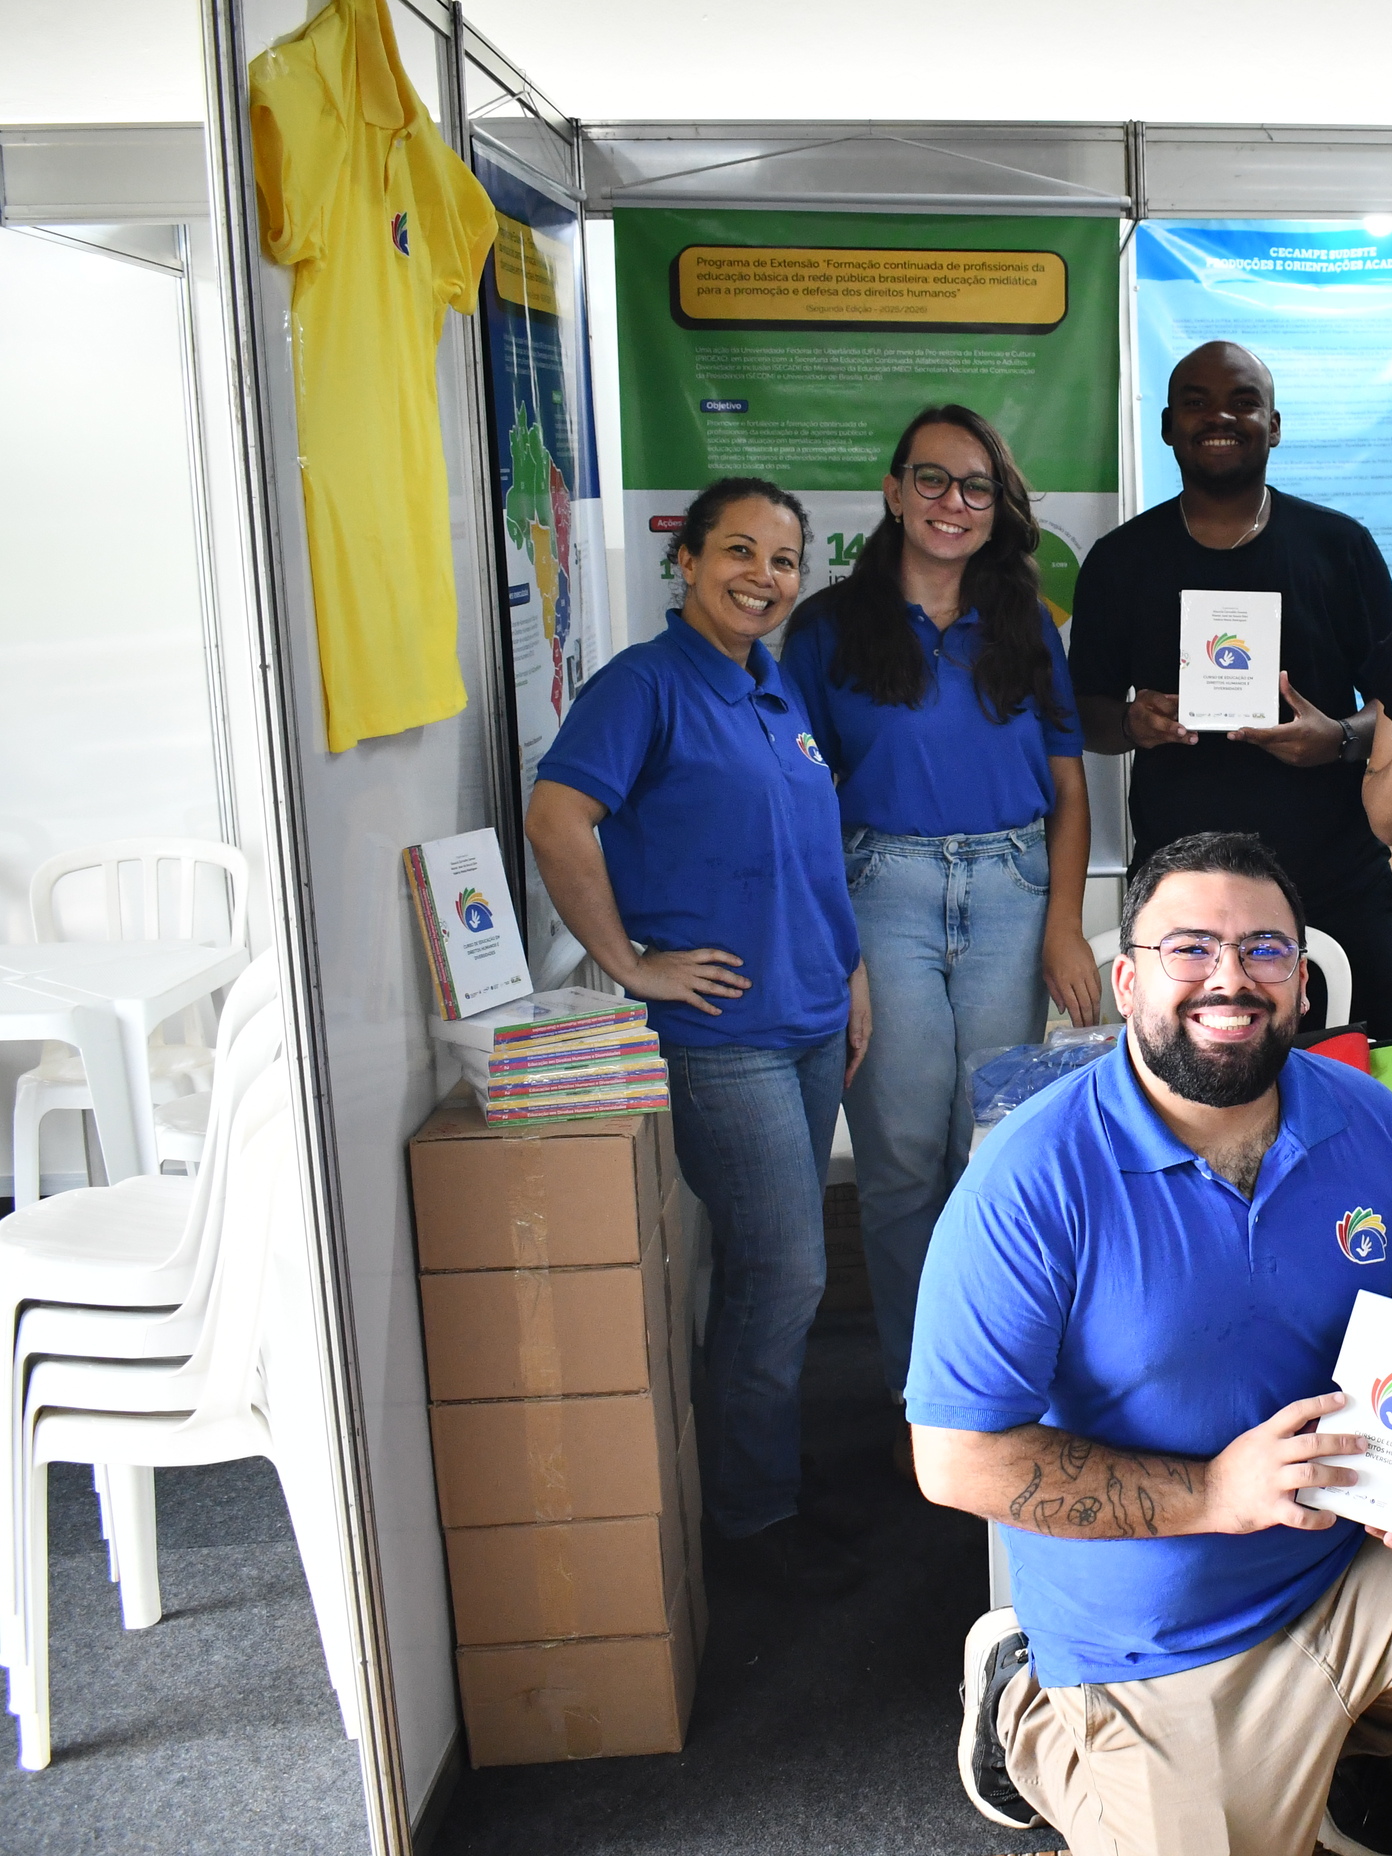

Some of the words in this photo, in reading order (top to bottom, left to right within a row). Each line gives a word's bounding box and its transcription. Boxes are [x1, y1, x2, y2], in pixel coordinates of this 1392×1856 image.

[1269, 246, 1327, 259] CECAMPE
[1331, 247, 1377, 259] SUDESTE
[697, 257, 749, 269] Programa
[754, 258, 767, 268] de
[771, 258, 820, 269] Extensão
[884, 260, 944, 271] continuada
[947, 261, 960, 271] de
[963, 261, 1030, 273] profissionais
[1032, 262, 1045, 272] da
[1205, 256, 1274, 272] PRODUÇÕES
[1276, 260, 1283, 270] E
[1285, 257, 1362, 273] ORIENTAÇÕES
[696, 271, 751, 283] educação
[754, 271, 788, 281] básica
[791, 272, 805, 282] da
[808, 273, 833, 283] rede
[836, 273, 875, 285] pública
[933, 275, 986, 287] educação
[989, 276, 1037, 286] midiática
[697, 286, 721, 297] para
[725, 287, 731, 295] a
[734, 286, 790, 298] promoção
[793, 288, 800, 296] e
[802, 286, 839, 296] defesa
[842, 287, 862, 297] dos
[864, 287, 904, 298] direitos
[706, 402, 741, 411] Objetivo
[657, 519, 682, 529] Ações
[1355, 1430, 1376, 1442] CURSO
[1376, 1436, 1384, 1444] DE
[1367, 1442, 1385, 1454] EITOS
